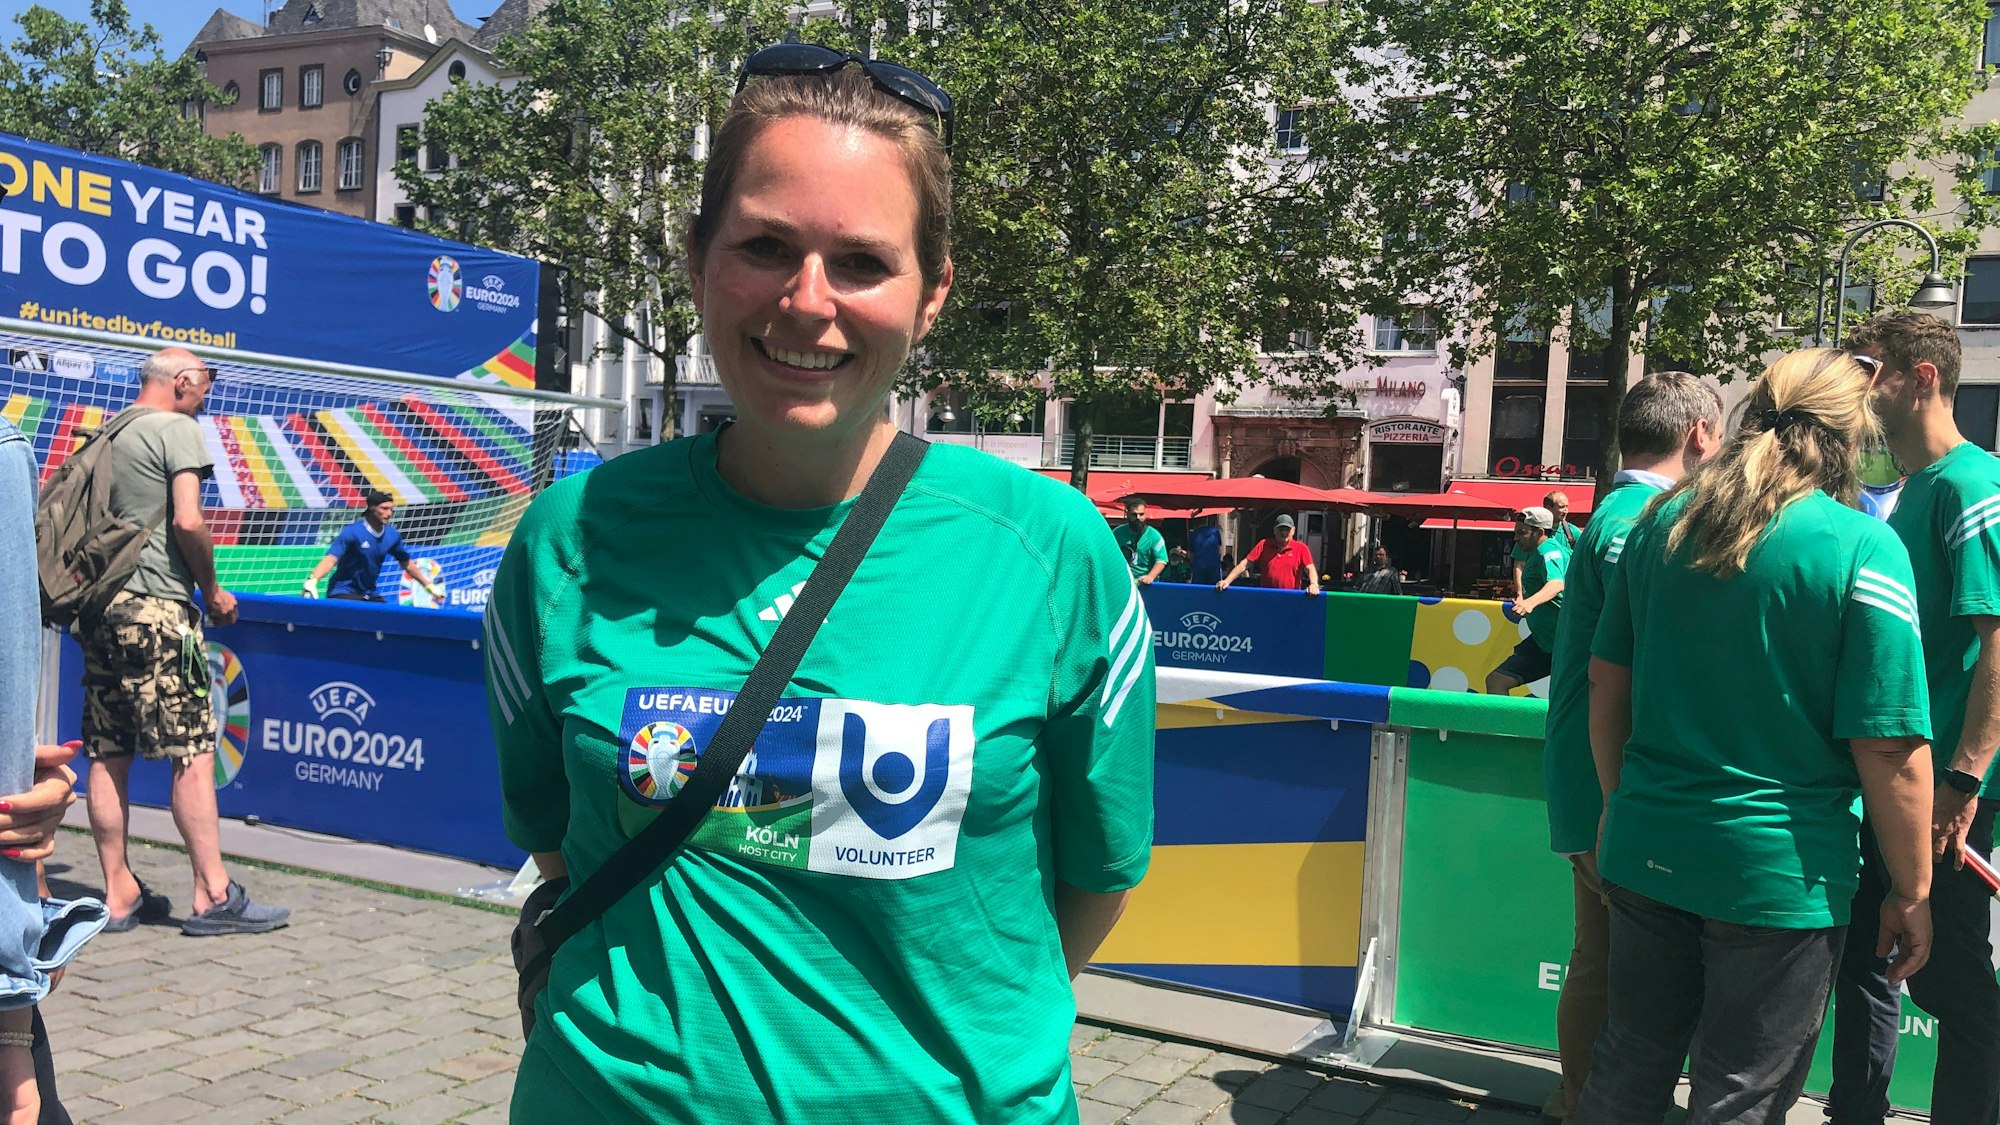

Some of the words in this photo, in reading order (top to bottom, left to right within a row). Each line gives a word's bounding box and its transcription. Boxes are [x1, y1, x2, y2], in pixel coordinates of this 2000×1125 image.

[0, 152, 112, 217] ONE
[121, 179, 268, 250] YEAR
[0, 208, 107, 286] TO
[127, 237, 268, 315] GO!
[465, 285, 520, 308] EURO2024
[476, 302, 507, 315] GERMANY
[19, 301, 237, 349] #unitedbyfootball
[1374, 423, 1440, 436] RISTORANTE
[1383, 432, 1430, 442] PIZZERIA
[1495, 456, 1577, 478] Oscar
[450, 588, 490, 606] EURO
[1181, 614, 1219, 630] UEFA
[1152, 630, 1253, 653] EURO2024
[1172, 650, 1228, 664] GERMANY
[312, 687, 369, 722] UEFA
[262, 717, 425, 772] EURO2024
[295, 760, 384, 792] GERMANY
[745, 825, 799, 850] KÖLN
[738, 843, 769, 858] HOST
[770, 850, 798, 863] CITY
[834, 846, 935, 866] VOLUNTEER
[1538, 961, 1570, 992] E
